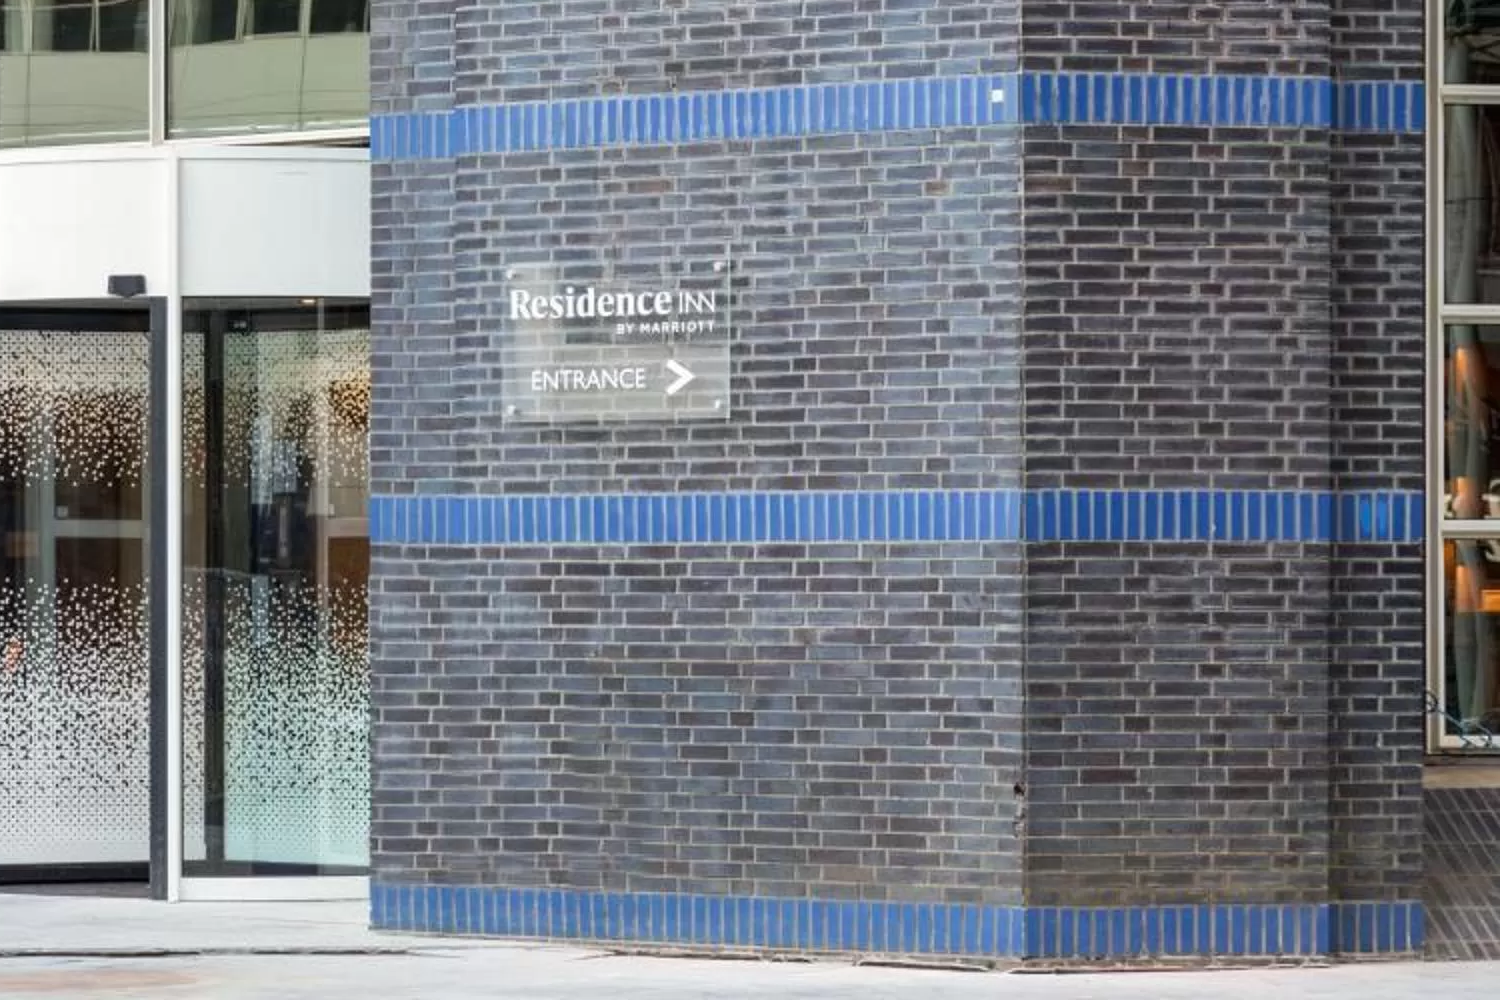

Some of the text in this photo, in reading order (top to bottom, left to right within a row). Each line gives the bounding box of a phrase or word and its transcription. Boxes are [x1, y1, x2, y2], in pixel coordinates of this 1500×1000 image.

[510, 286, 716, 320] Residence INN
[615, 319, 715, 335] BY MARRIOTT
[531, 367, 647, 392] ENTRANCE
